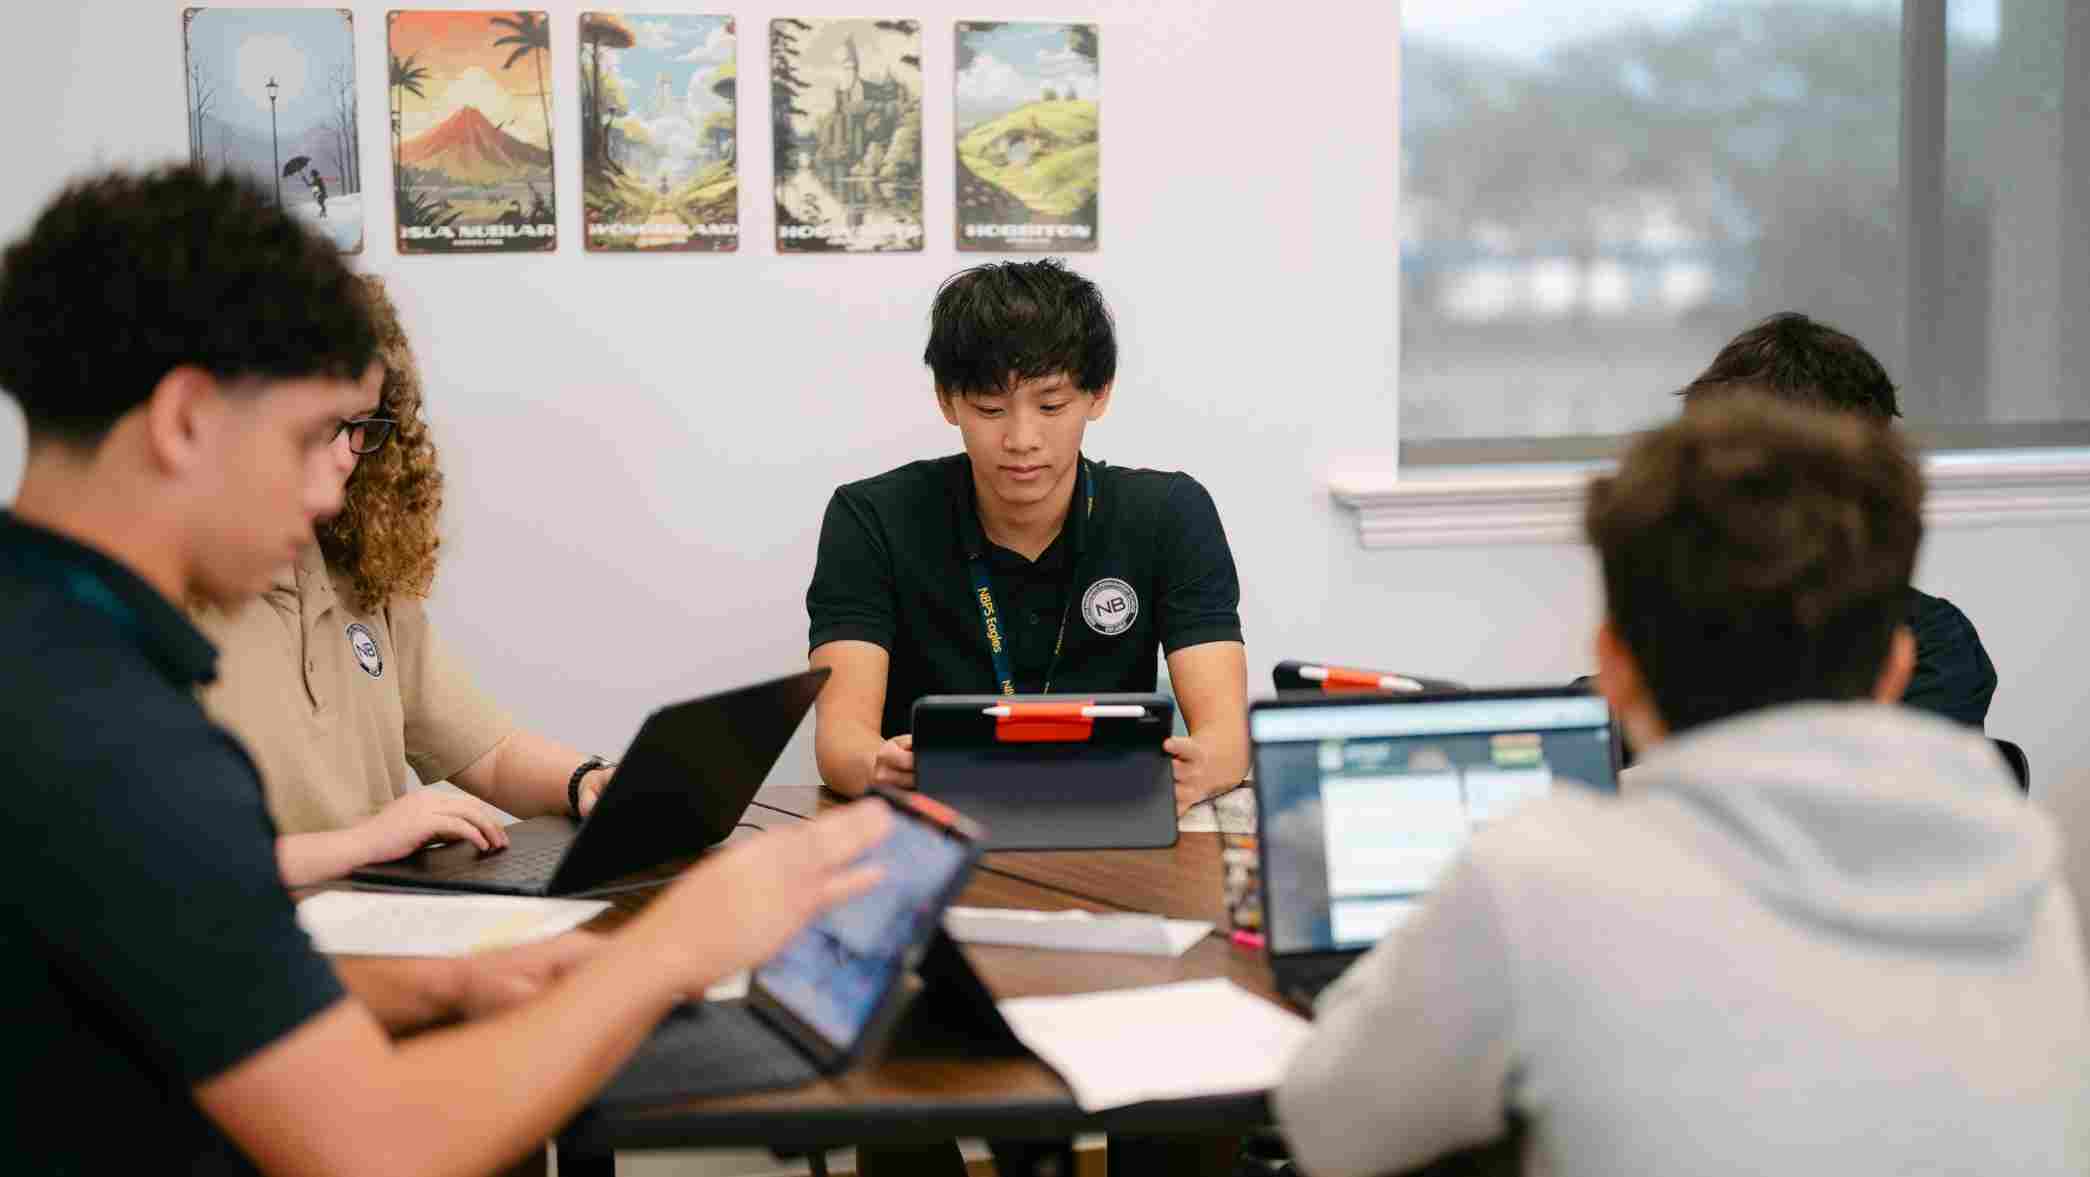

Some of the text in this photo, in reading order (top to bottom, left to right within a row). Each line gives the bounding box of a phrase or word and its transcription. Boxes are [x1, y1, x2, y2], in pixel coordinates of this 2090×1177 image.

[400, 224, 555, 239] ISLA NUBLAR
[778, 225, 922, 238] HOGS
[1095, 597, 1126, 617] NB
[977, 586, 1003, 654] NBPS Eagles
